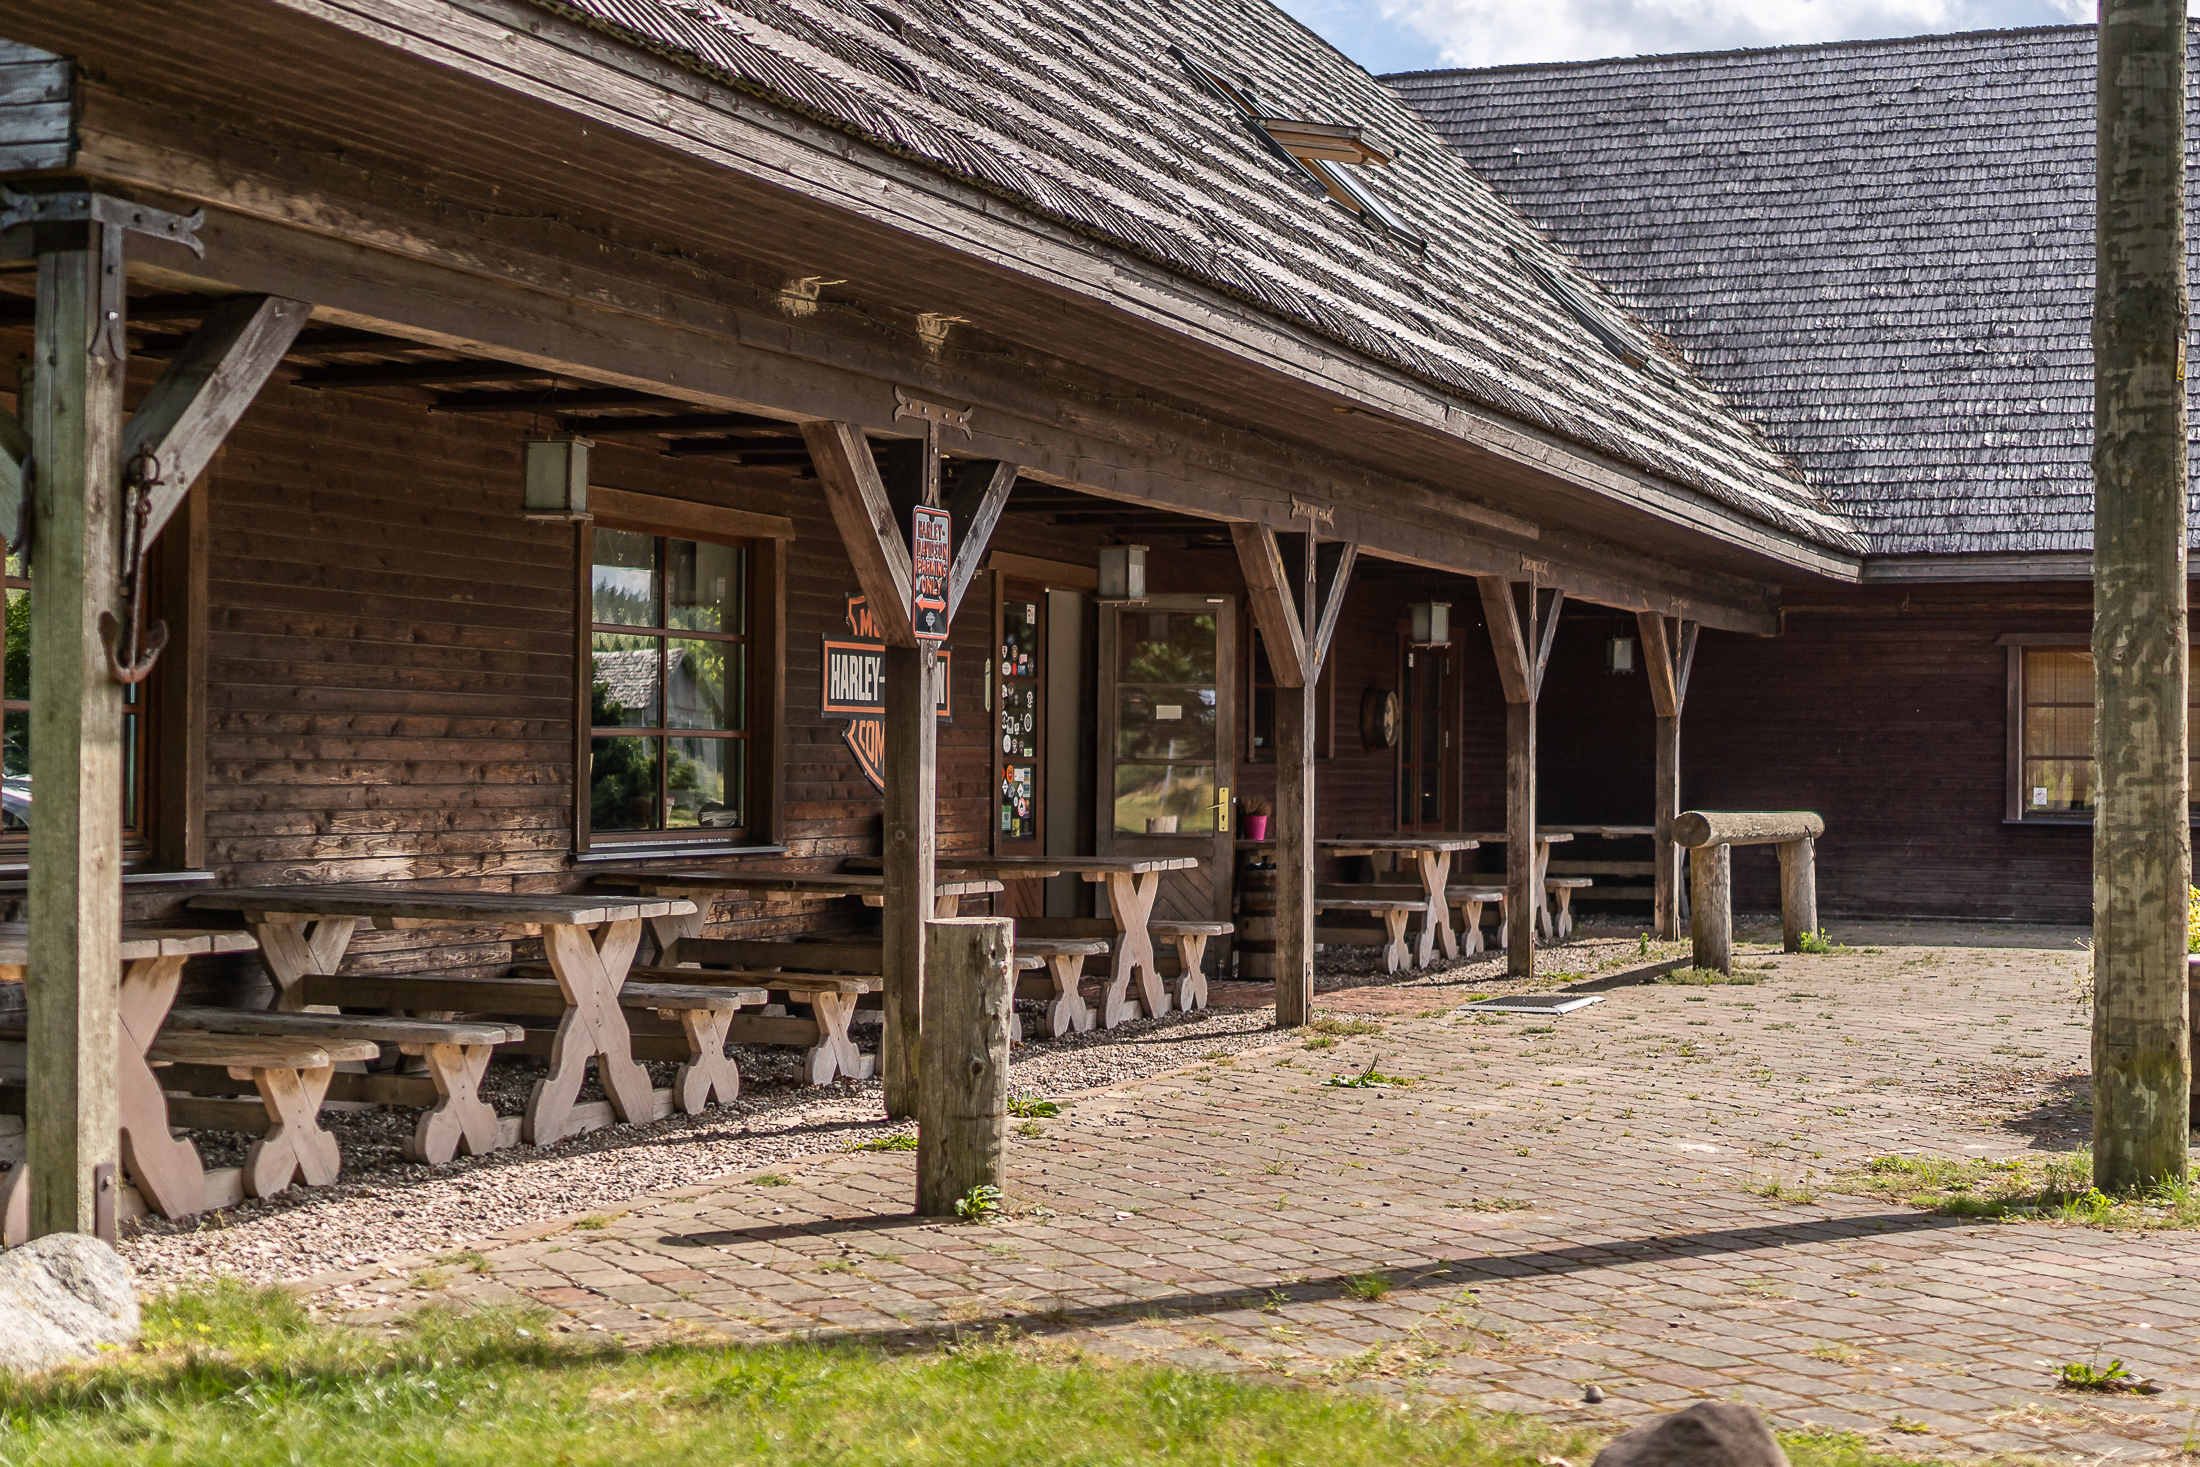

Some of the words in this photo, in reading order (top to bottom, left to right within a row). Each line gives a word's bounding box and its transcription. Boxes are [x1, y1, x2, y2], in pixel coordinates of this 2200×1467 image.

[917, 520, 946, 542] HARLEY-
[916, 538, 948, 560] DAVIDSON
[917, 557, 948, 579] PARKING
[921, 577, 943, 596] ONLY
